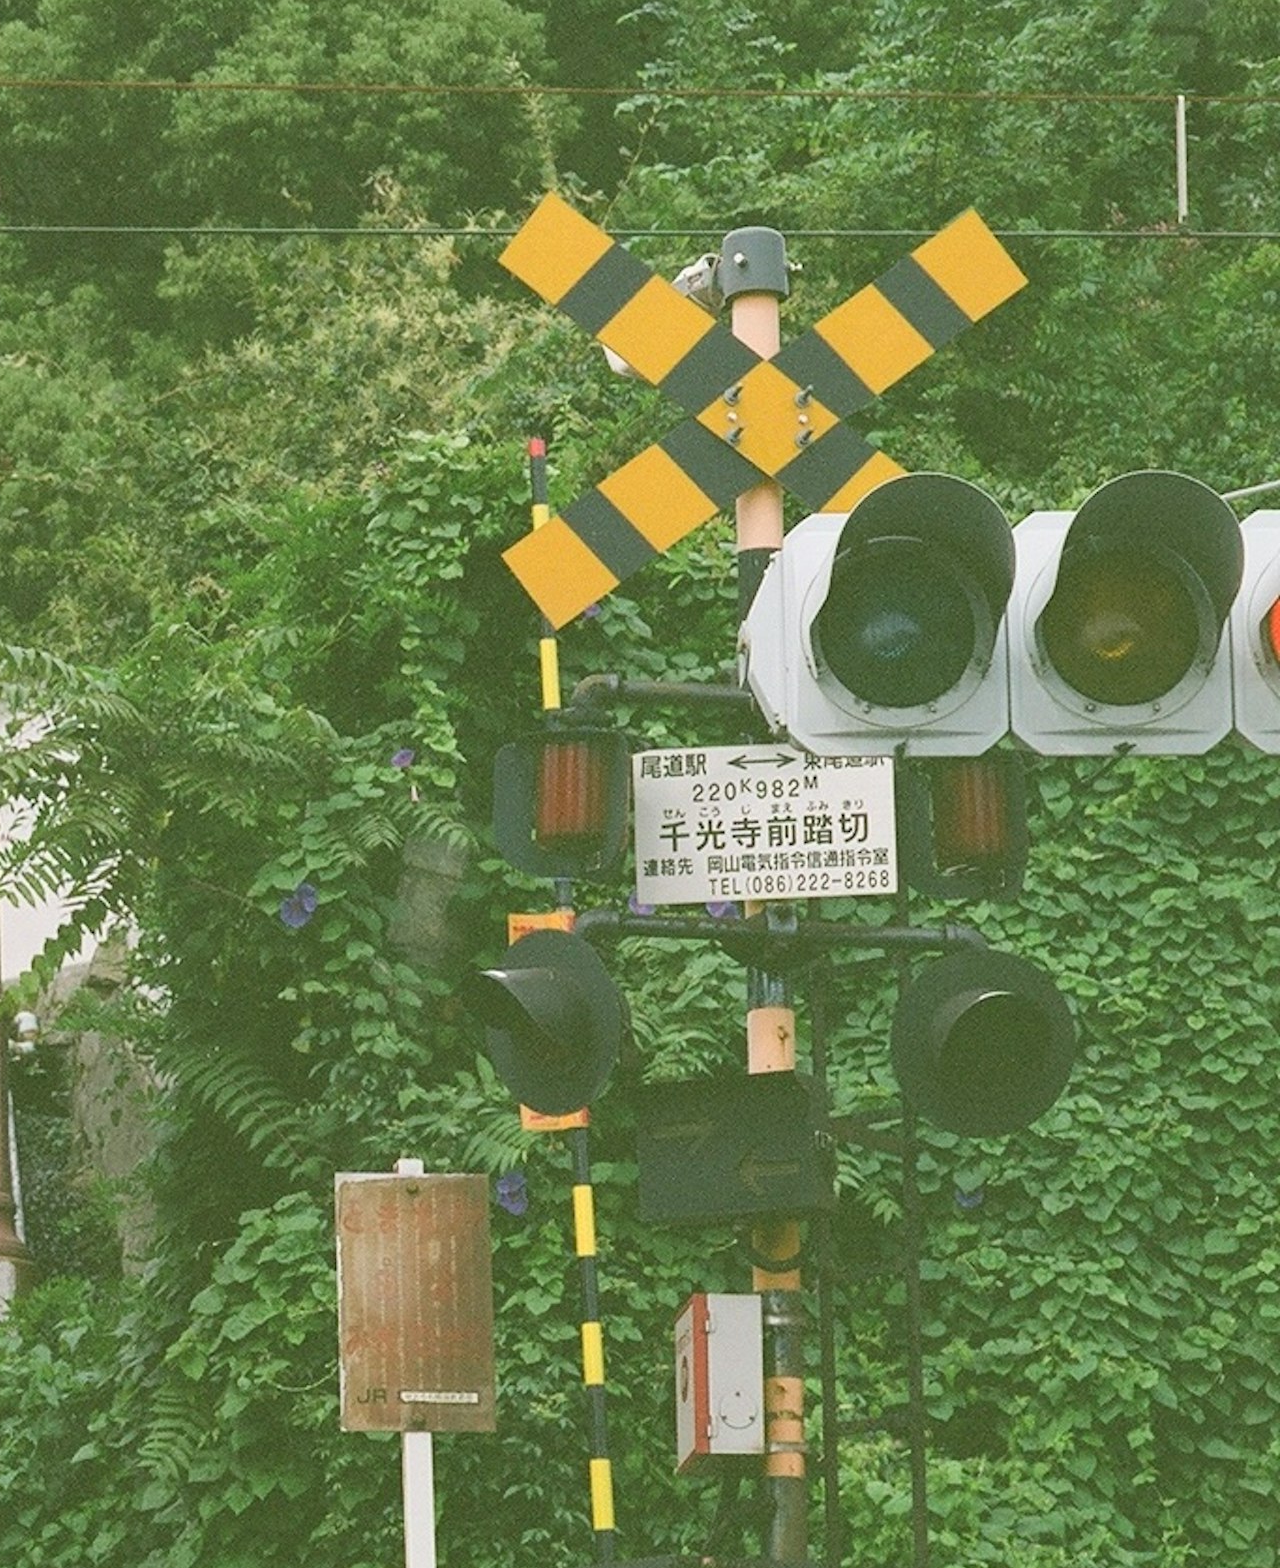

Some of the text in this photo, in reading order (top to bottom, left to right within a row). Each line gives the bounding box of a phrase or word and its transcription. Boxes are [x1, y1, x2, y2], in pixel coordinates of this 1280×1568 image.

[640, 754, 707, 779] 尾道駅
[659, 813, 868, 852] 千光寺前踏切
[643, 856, 694, 877] 連絡先
[709, 869, 889, 896] TEL(086)222-8268
[357, 1388, 387, 1404] JR
